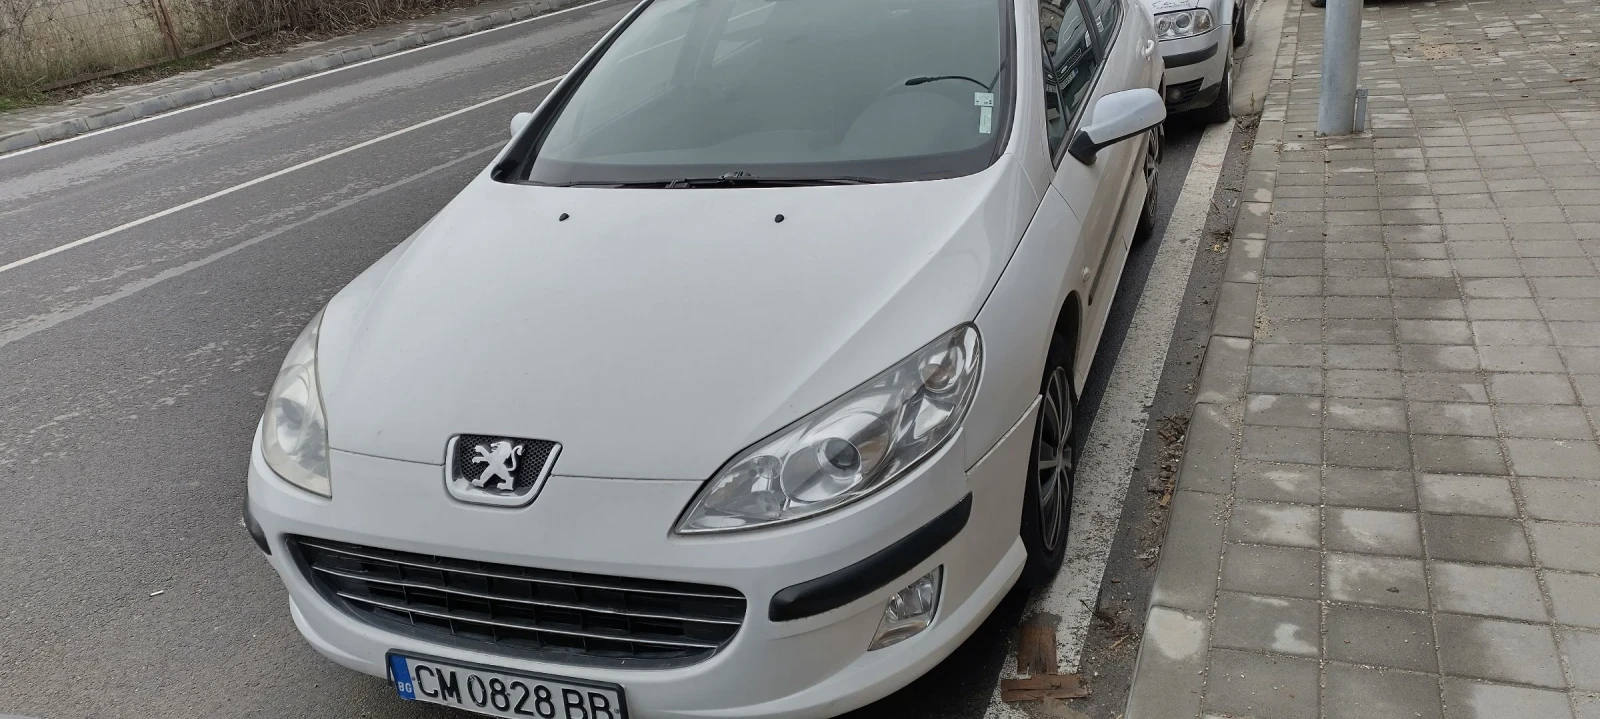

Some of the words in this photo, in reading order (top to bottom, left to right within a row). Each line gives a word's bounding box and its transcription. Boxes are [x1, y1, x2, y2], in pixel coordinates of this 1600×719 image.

[397, 681, 412, 693] BG
[415, 664, 462, 704] CM
[467, 674, 556, 719] 0828
[562, 688, 614, 719] BB
